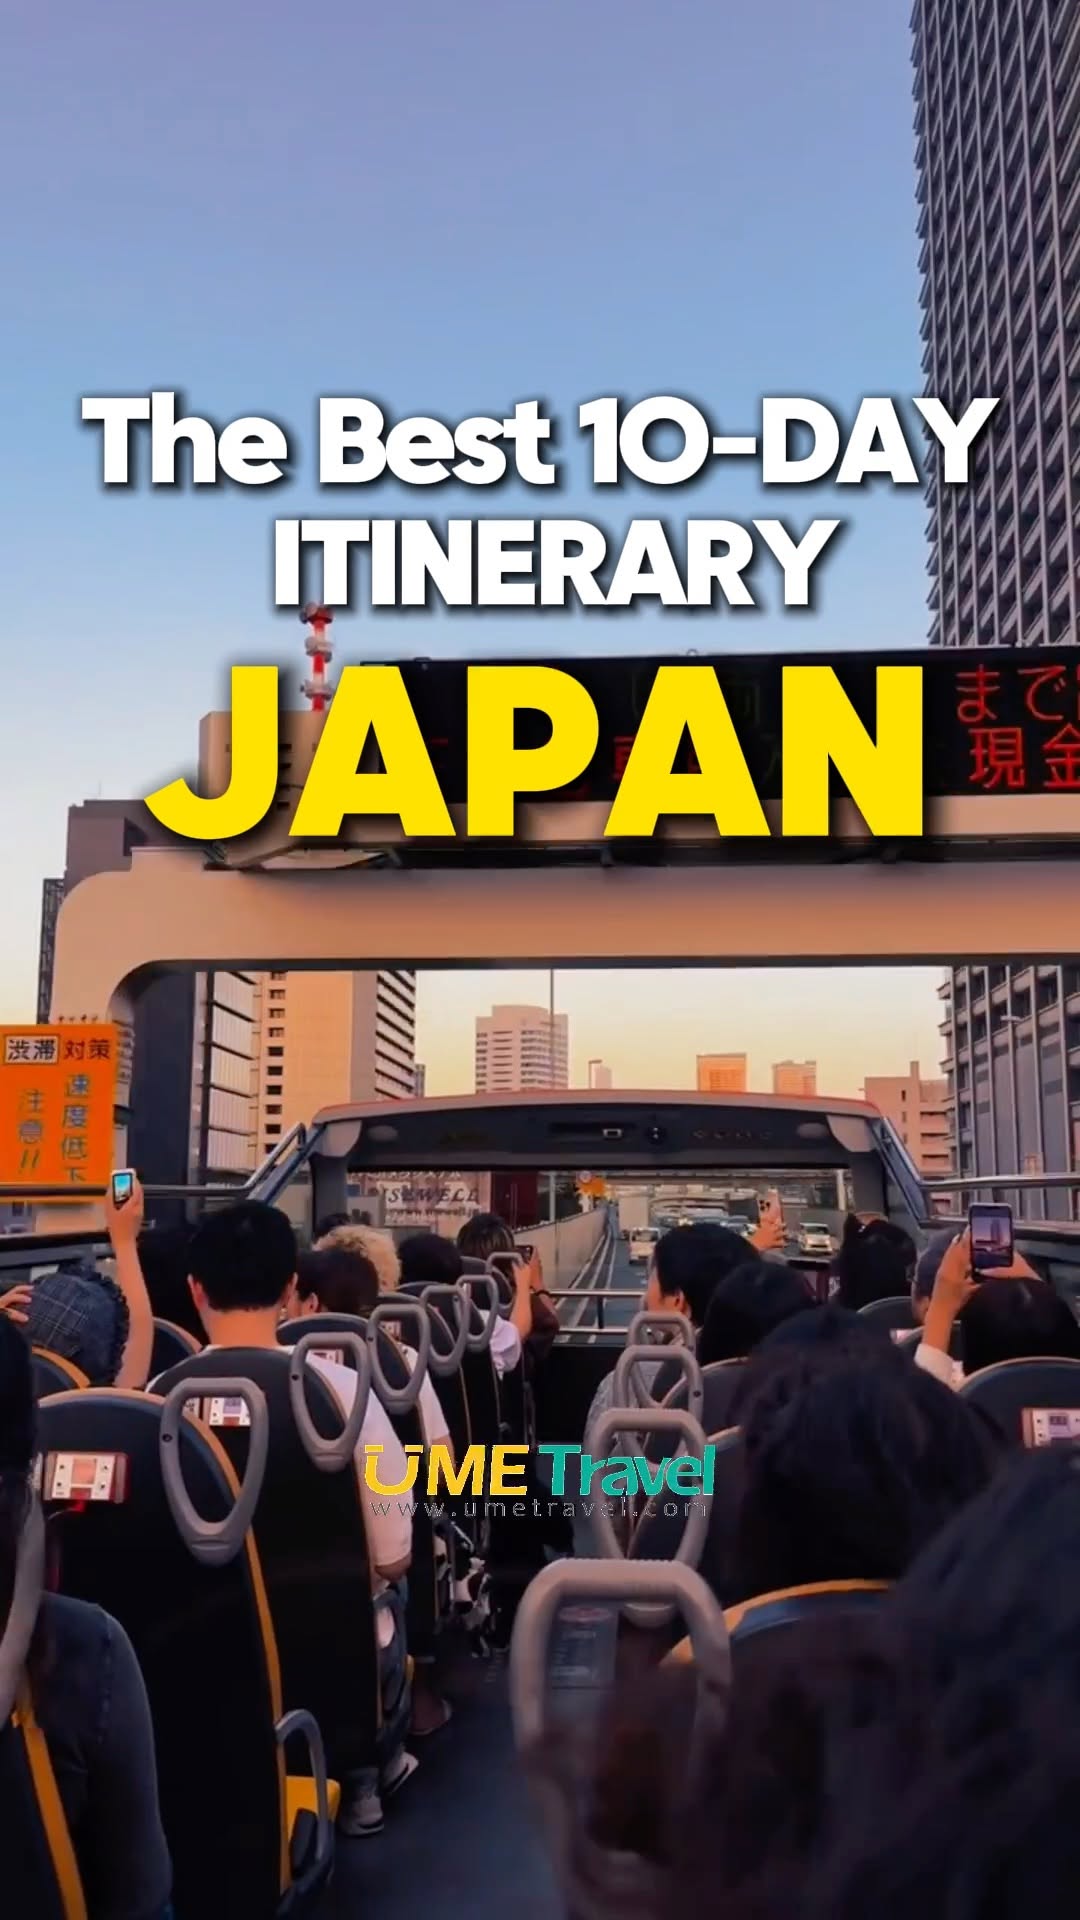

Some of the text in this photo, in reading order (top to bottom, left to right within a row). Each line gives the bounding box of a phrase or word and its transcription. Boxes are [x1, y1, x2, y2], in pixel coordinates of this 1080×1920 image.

[956, 664, 1080, 723] まで
[64, 1039, 111, 1061] 対策
[61, 1073, 91, 1182] 速度低下
